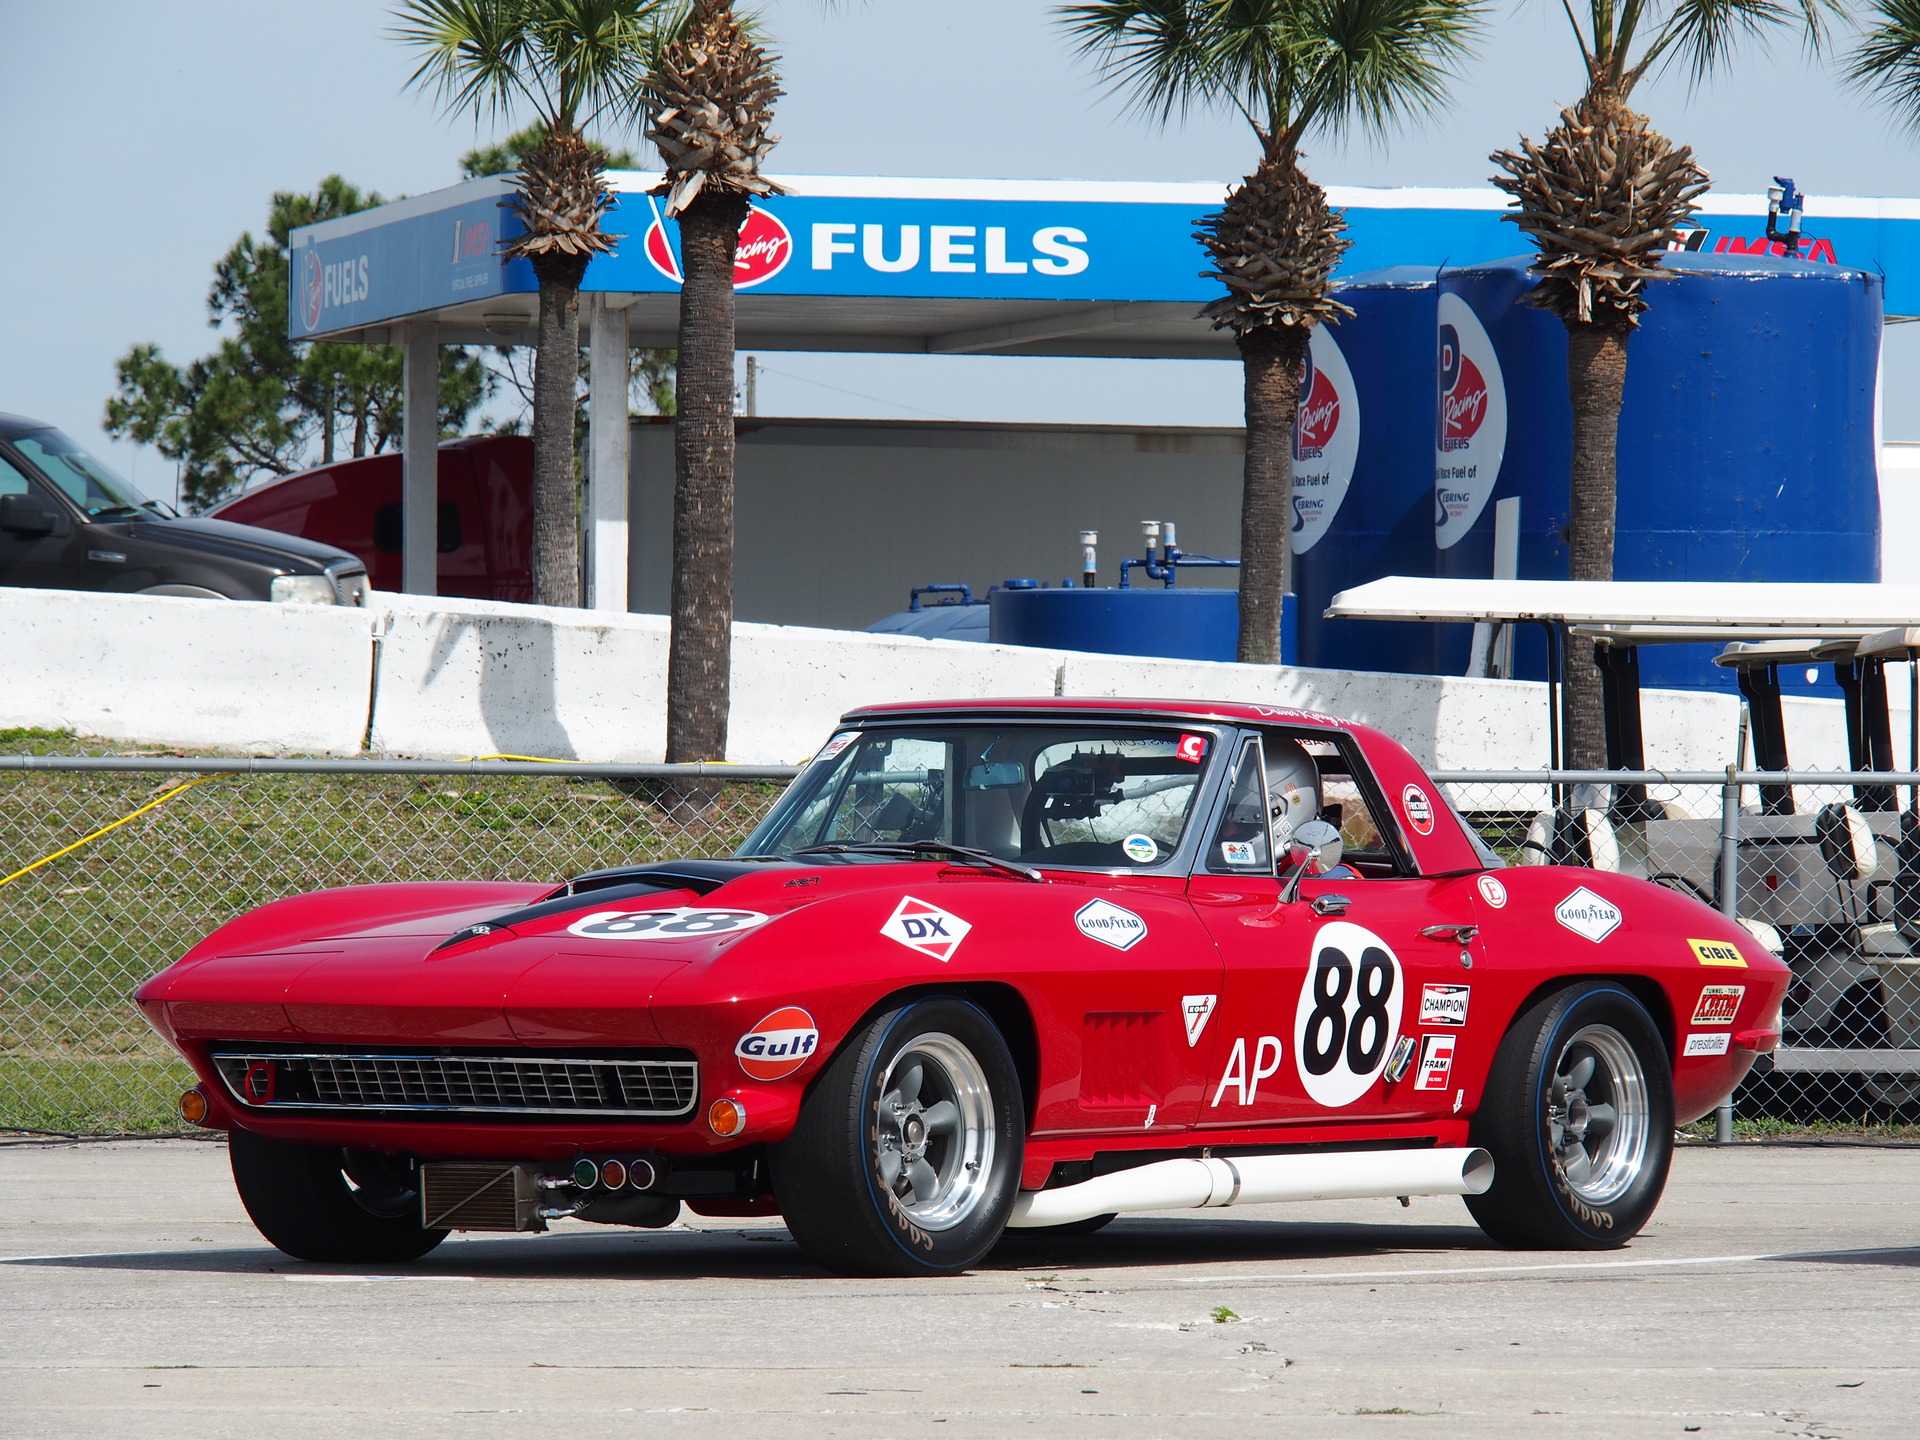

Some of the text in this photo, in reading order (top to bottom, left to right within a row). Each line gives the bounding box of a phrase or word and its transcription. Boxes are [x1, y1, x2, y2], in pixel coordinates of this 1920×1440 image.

[734, 235, 789, 269] acing
[811, 223, 1090, 276] FUELS
[324, 254, 368, 309] FUELS
[1300, 399, 1340, 440] Racing
[1444, 387, 1487, 436] Racing
[1300, 447, 1323, 459] FUELS
[1444, 438, 1470, 451] FUELS
[1306, 473, 1320, 486] Fuel
[1321, 472, 1330, 486] of
[1452, 465, 1467, 479] Fuel
[1468, 464, 1477, 478] of
[1183, 736, 1202, 757] C
[1229, 852, 1250, 861] NCRS
[784, 876, 821, 888] 427
[1483, 880, 1502, 901] E
[581, 912, 756, 934] 88
[901, 917, 951, 938] DX
[1188, 1005, 1208, 1014] KONI
[1302, 946, 1396, 1077] 88
[1424, 998, 1465, 1012] CHAMPION
[740, 1033, 817, 1057] Gulf
[1688, 1036, 1725, 1053] prestolite
[1210, 1036, 1283, 1108] AP
[1424, 1060, 1448, 1070] FRAM
